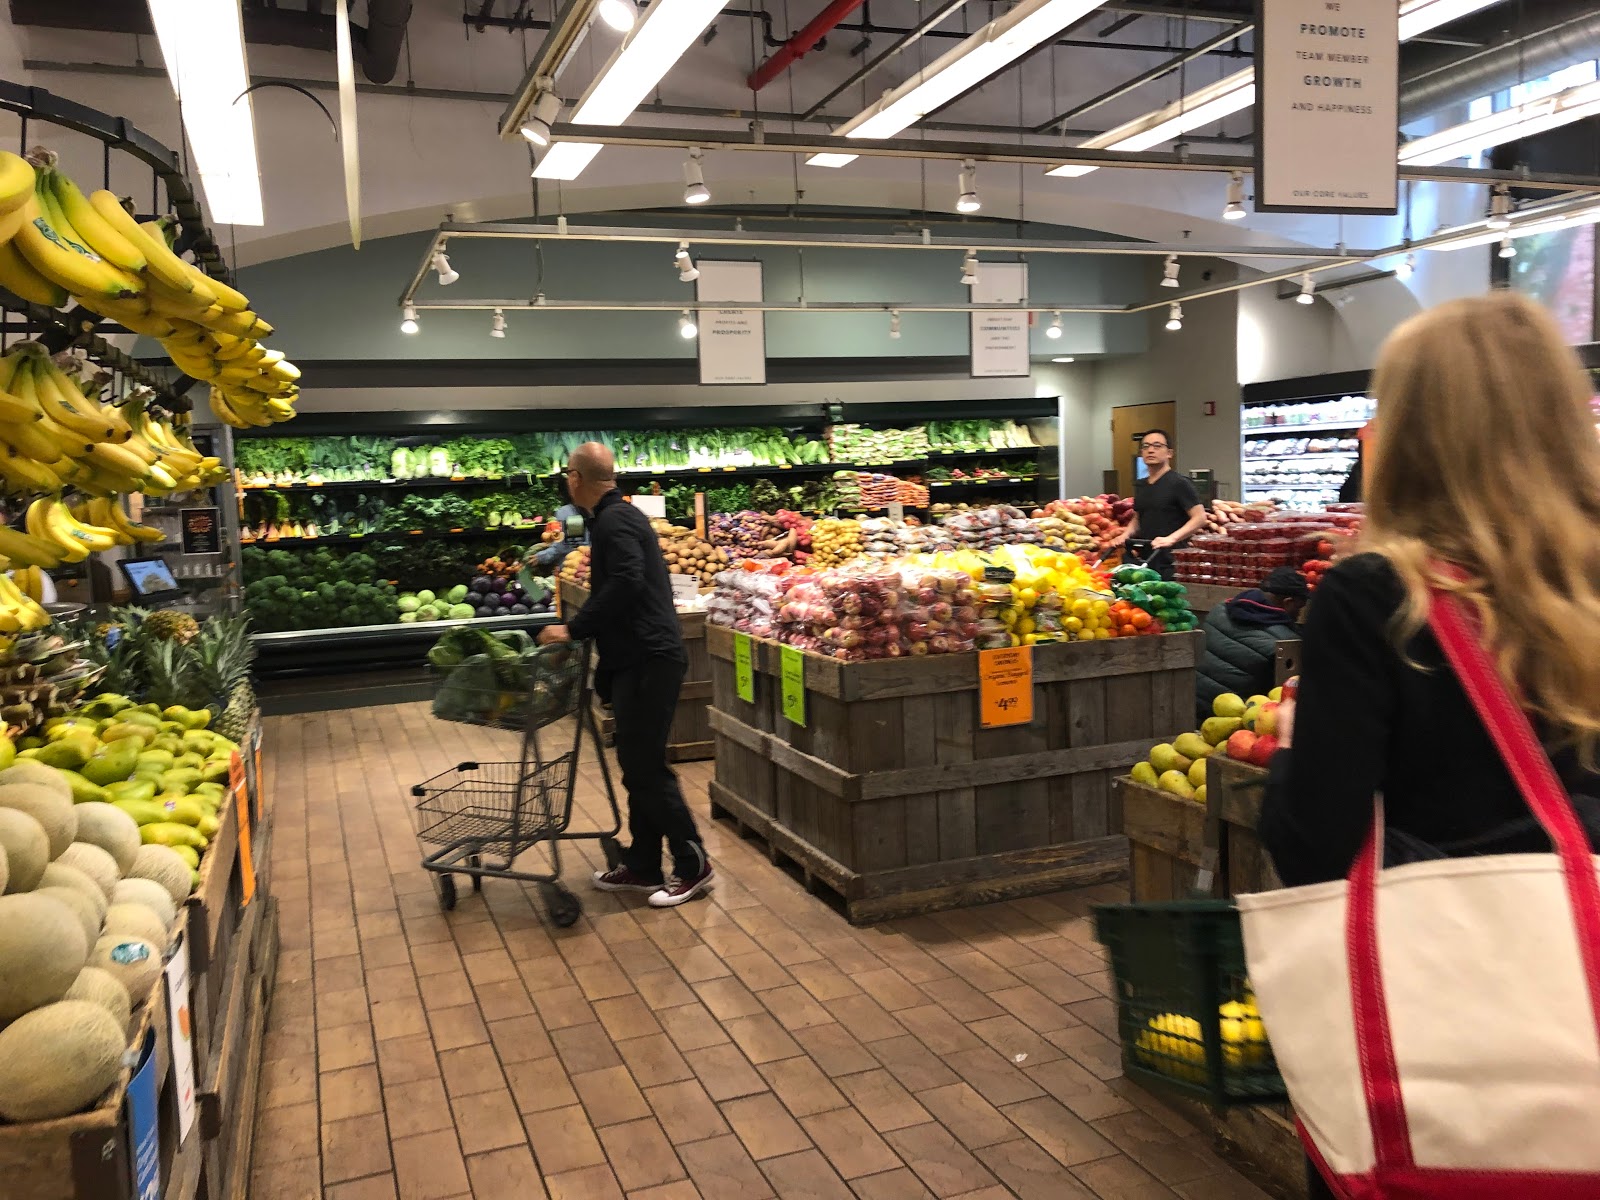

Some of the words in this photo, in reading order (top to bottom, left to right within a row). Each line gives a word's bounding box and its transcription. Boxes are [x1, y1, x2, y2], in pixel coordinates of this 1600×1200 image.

[1325, 3, 1340, 12] WE
[1299, 24, 1366, 39] PROMOTE
[1296, 51, 1324, 61] TEAM
[1327, 53, 1370, 64] MEMBER
[1303, 75, 1362, 89] GROWTH
[1291, 102, 1314, 112] AND
[1317, 104, 1373, 115] HAPPINESS
[1293, 190, 1311, 198] OUR
[1313, 190, 1335, 199] CORE
